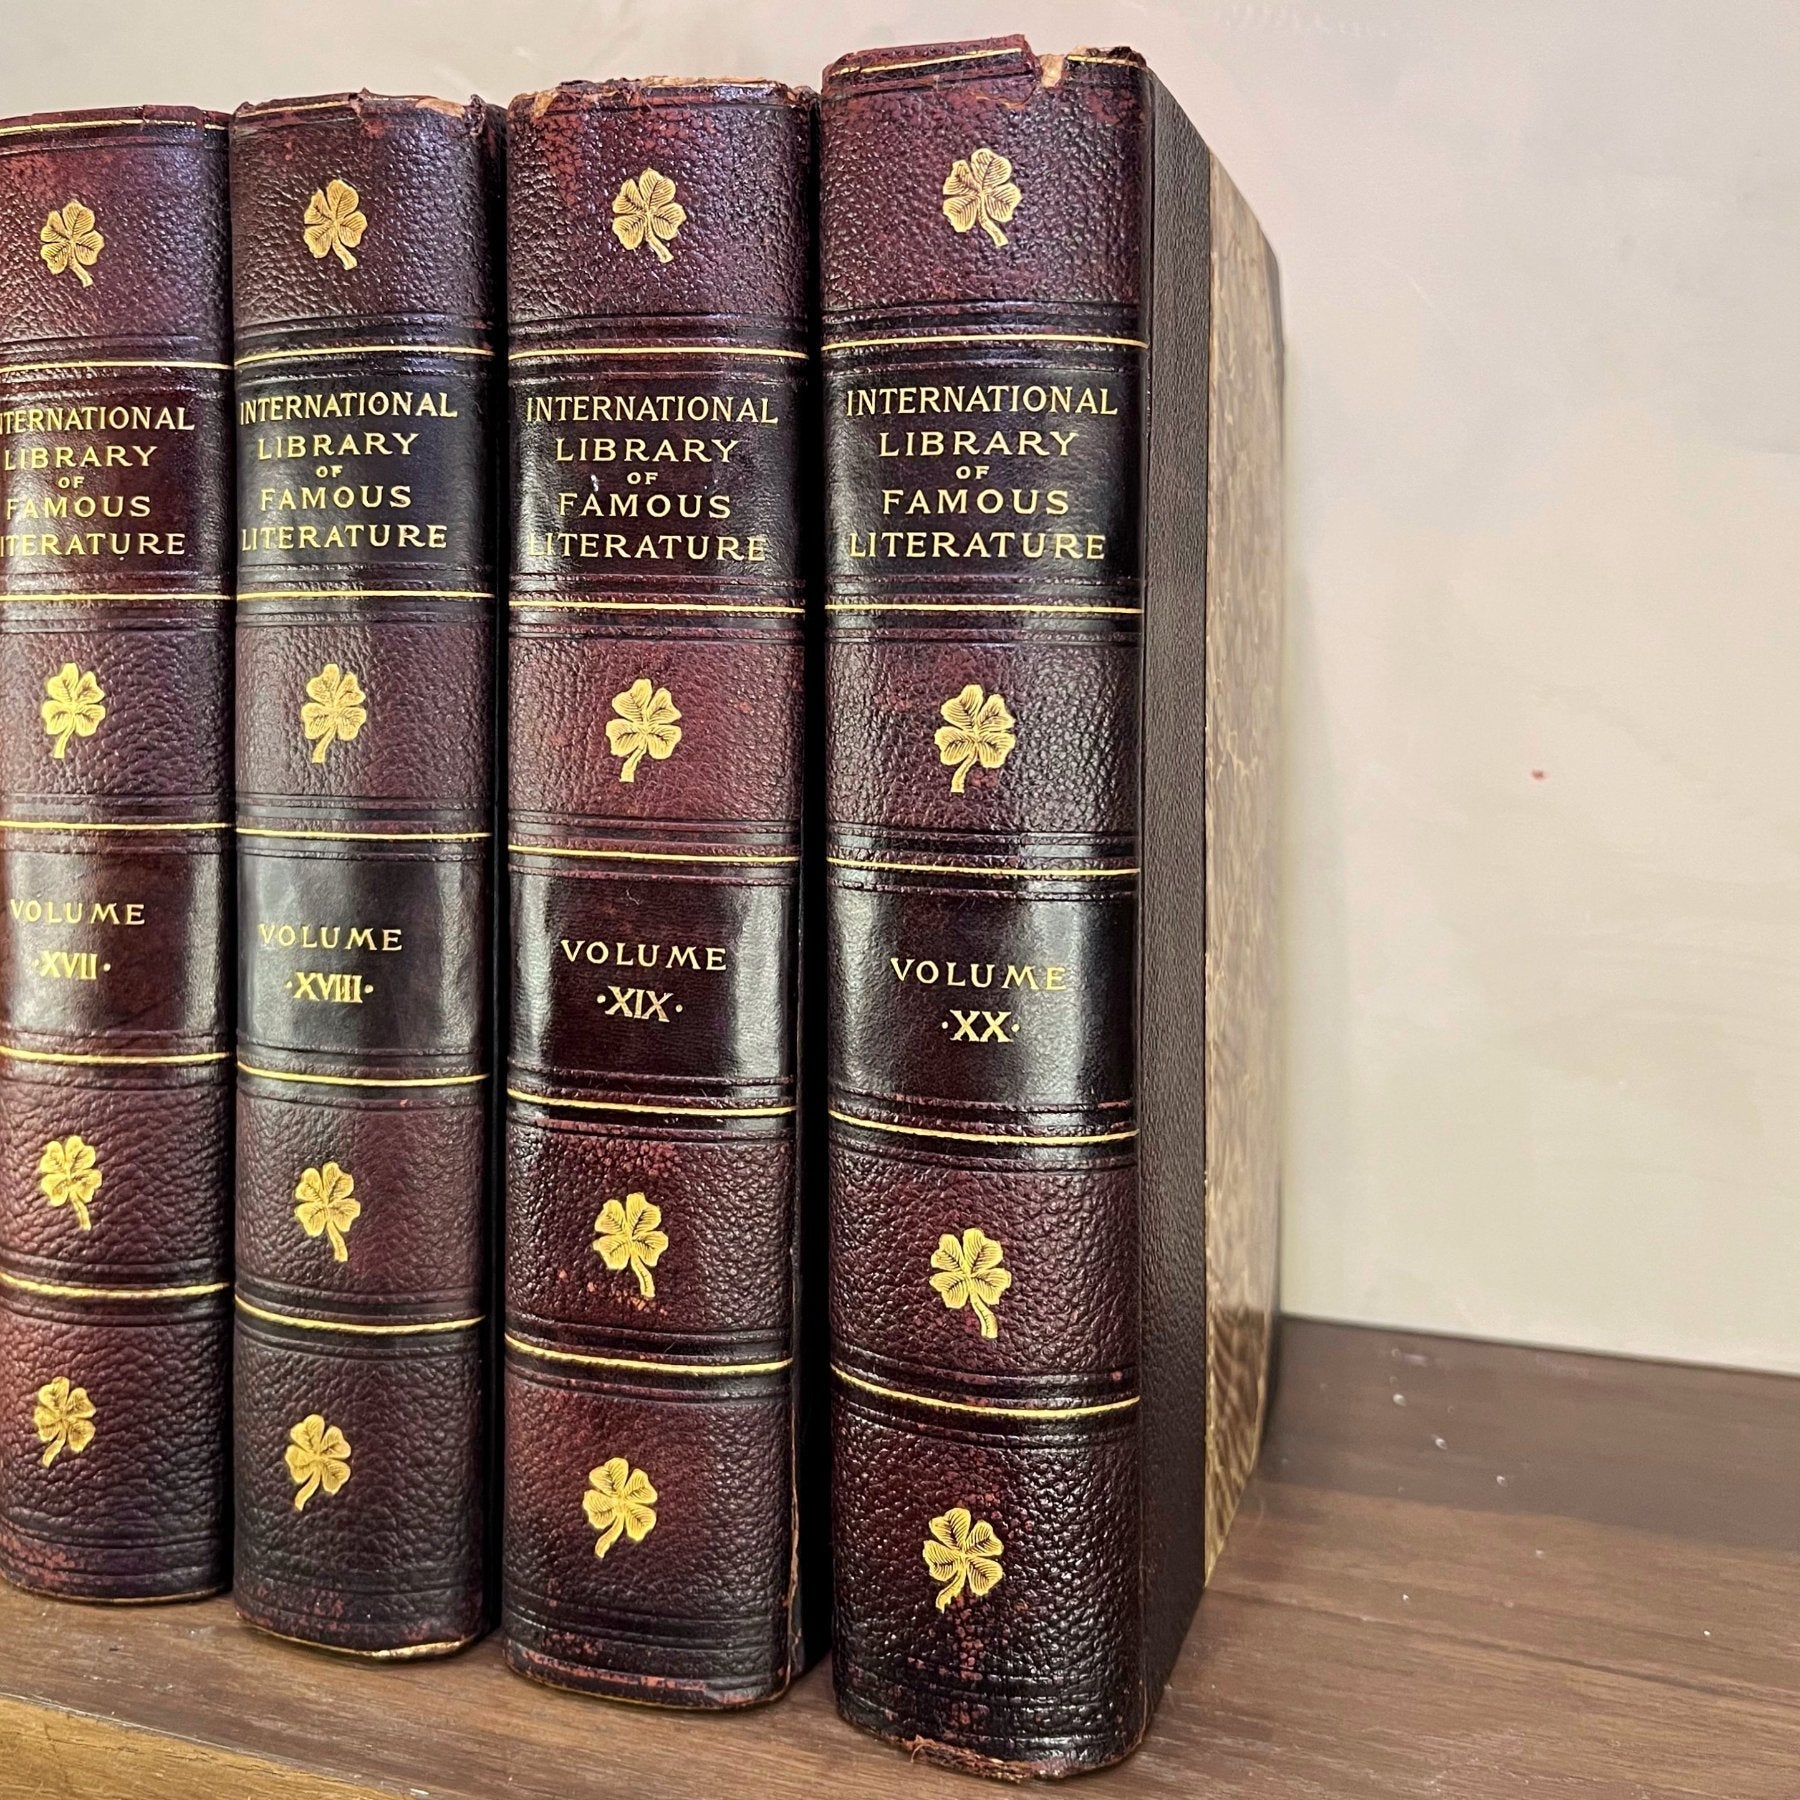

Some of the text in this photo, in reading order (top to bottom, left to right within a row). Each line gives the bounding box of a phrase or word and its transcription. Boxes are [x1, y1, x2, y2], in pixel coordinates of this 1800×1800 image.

[240, 391, 458, 425] INTERNATIONAL
[527, 396, 779, 423] INTERNATIONAL
[846, 385, 1118, 416] INTERNATIONAL
[0, 406, 196, 435] TERNATIONAL
[258, 432, 420, 460] LIBRARY
[555, 438, 740, 462] LIBRARY
[879, 430, 1079, 457] LIBRARY
[4, 445, 158, 471] LIBRARY
[58, 476, 85, 489] OF
[315, 466, 343, 478] OF
[627, 472, 659, 485] OF
[955, 465, 990, 480] OF
[6, 496, 151, 520] FAMOUS
[261, 485, 413, 511] FAMOUS
[559, 493, 731, 519] FAMOUS
[881, 488, 1070, 515] FAMOUS
[241, 524, 448, 552] LITERATURE
[527, 533, 767, 562] LITERATURE
[848, 532, 1106, 560] LITERATURE
[10, 900, 146, 925] VOLUME
[260, 923, 402, 951] VOLUME
[561, 940, 727, 971] VOLUME
[890, 957, 1067, 990] VOLUME
